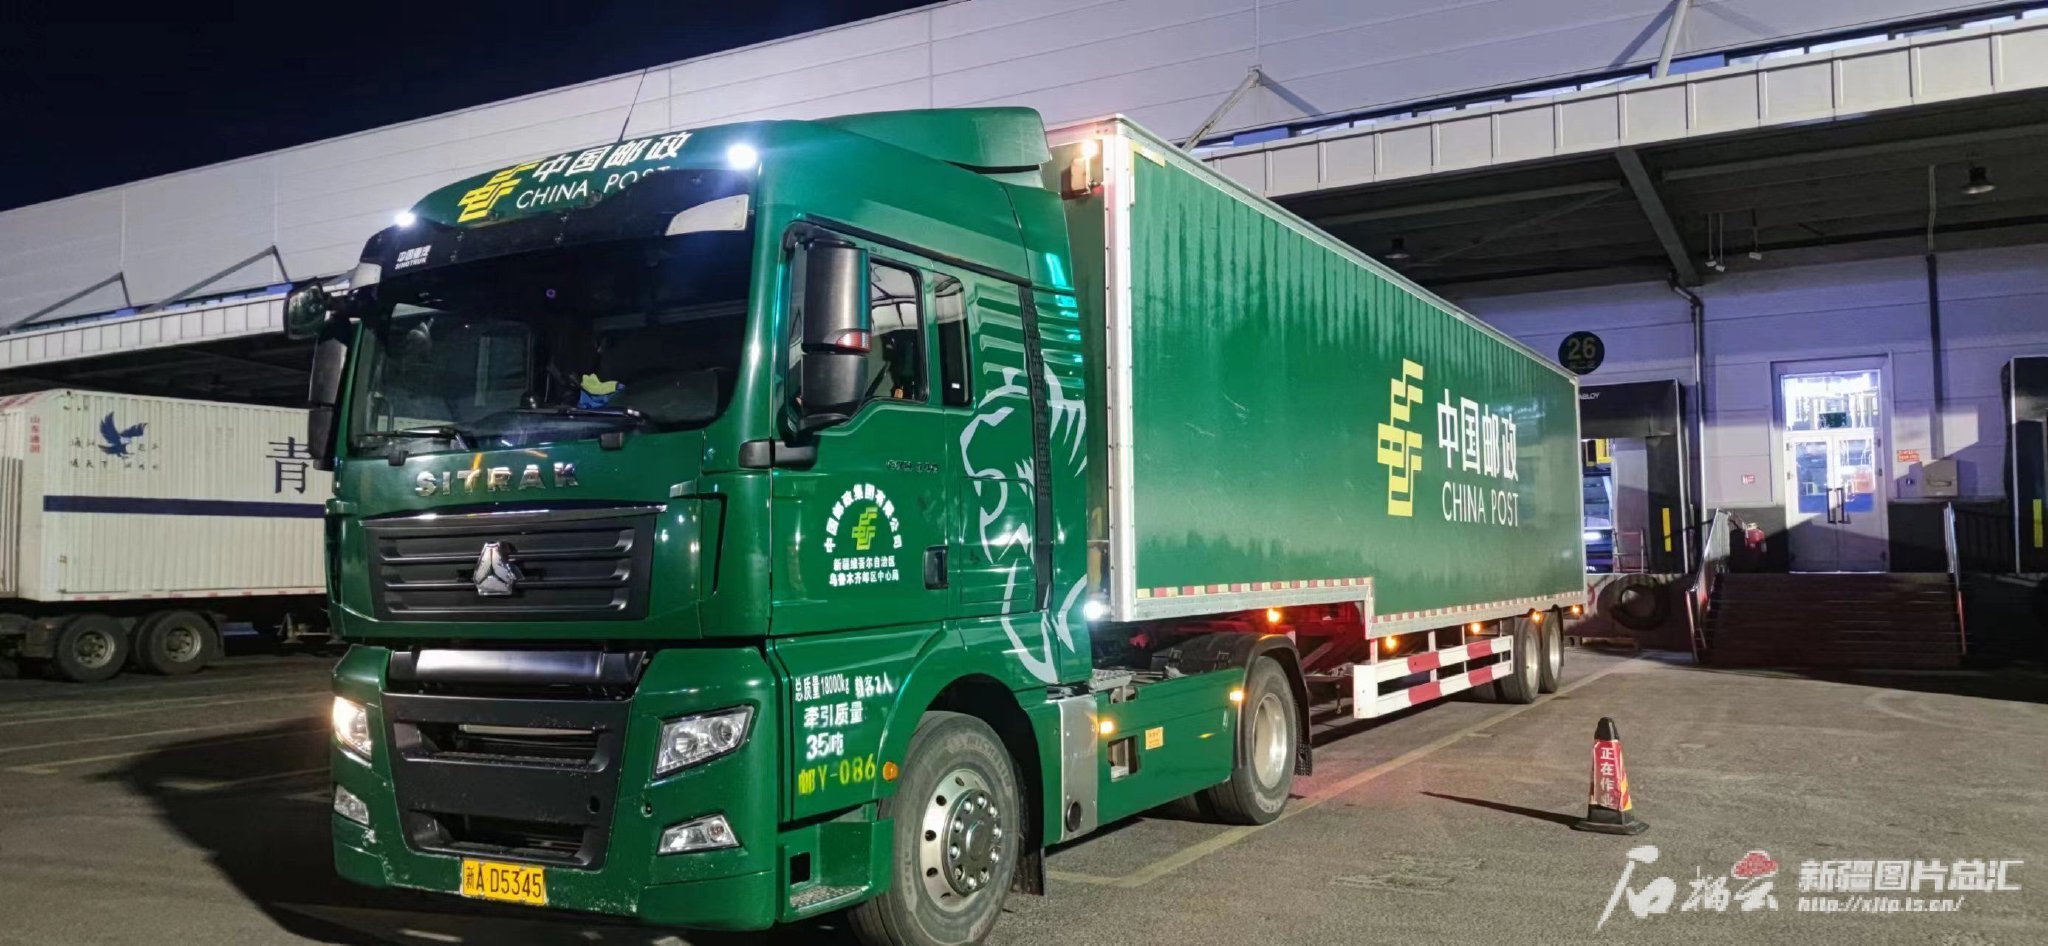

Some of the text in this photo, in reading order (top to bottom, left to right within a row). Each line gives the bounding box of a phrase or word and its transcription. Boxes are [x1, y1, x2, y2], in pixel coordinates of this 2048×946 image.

[532, 132, 692, 182] 中国邮政
[516, 166, 671, 209] CHINA PO
[1568, 337, 1597, 359] 26
[1437, 388, 1518, 482] 中国邮政
[415, 462, 579, 496] SITRAK
[1442, 481, 1519, 527] CHINA POST
[829, 569, 899, 587] 乌鲁木齐邮区中心局
[833, 556, 896, 571] 新疆维吾尔自治区
[804, 701, 863, 729] 牵引质量
[806, 732, 844, 761] 35吨
